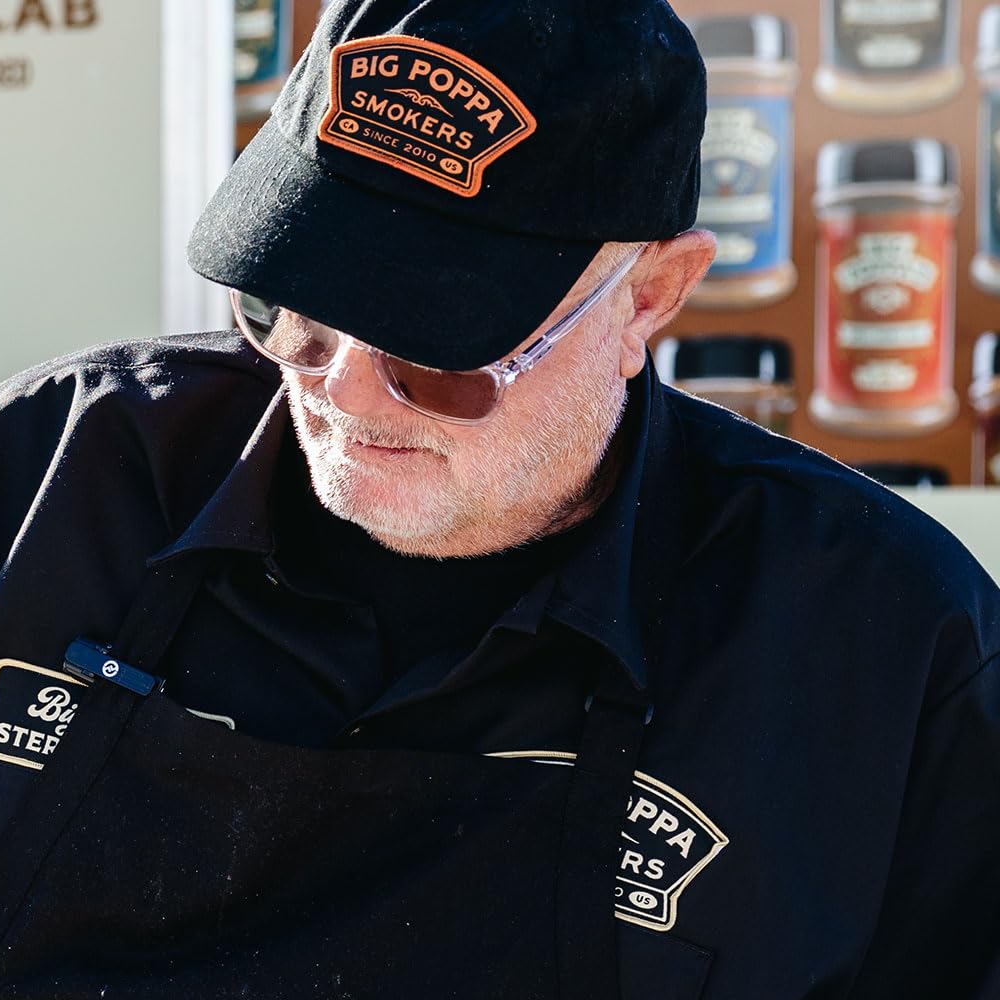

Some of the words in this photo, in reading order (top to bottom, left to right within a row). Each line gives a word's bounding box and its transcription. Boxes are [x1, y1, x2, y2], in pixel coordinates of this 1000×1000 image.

[351, 55, 398, 78] BIG
[408, 59, 503, 133] POPPA
[350, 91, 473, 149] SMOKERS
[363, 128, 398, 147] SINCE
[403, 144, 436, 161] 2010
[636, 893, 651, 905] US
